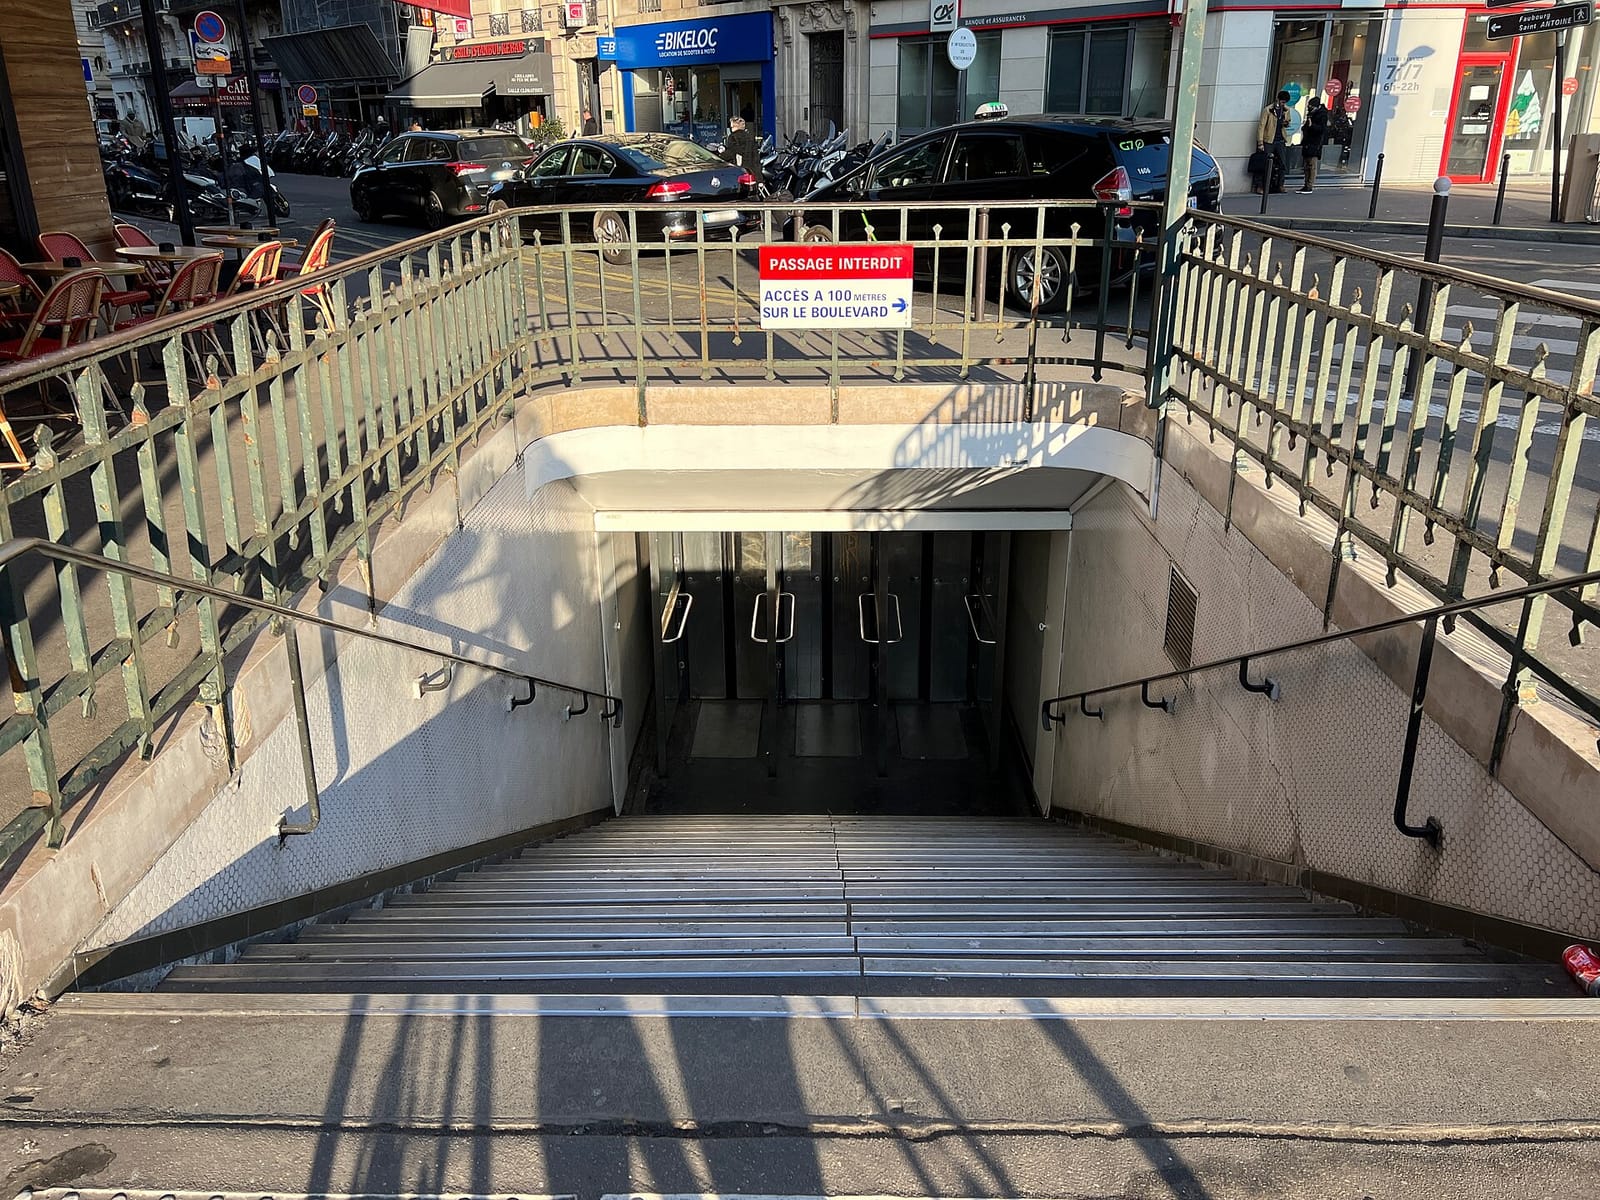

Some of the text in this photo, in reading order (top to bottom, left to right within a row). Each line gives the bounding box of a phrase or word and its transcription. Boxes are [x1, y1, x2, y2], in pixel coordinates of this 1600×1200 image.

[993, 15, 1026, 23] ASSURANCES
[1519, 13, 1551, 23] Faubourg
[1519, 17, 1572, 31] Saint ANTOINE
[664, 28, 718, 50] BIKELOC
[501, 41, 525, 55] KEBAB
[1383, 82, 1420, 91] 6h-22h
[769, 257, 903, 271] PASSAGE INTERDIT
[764, 288, 809, 302] ACCÈS
[814, 291, 823, 302] A
[828, 289, 852, 302] 100
[763, 306, 888, 318] SUR LE BOULEVARD
